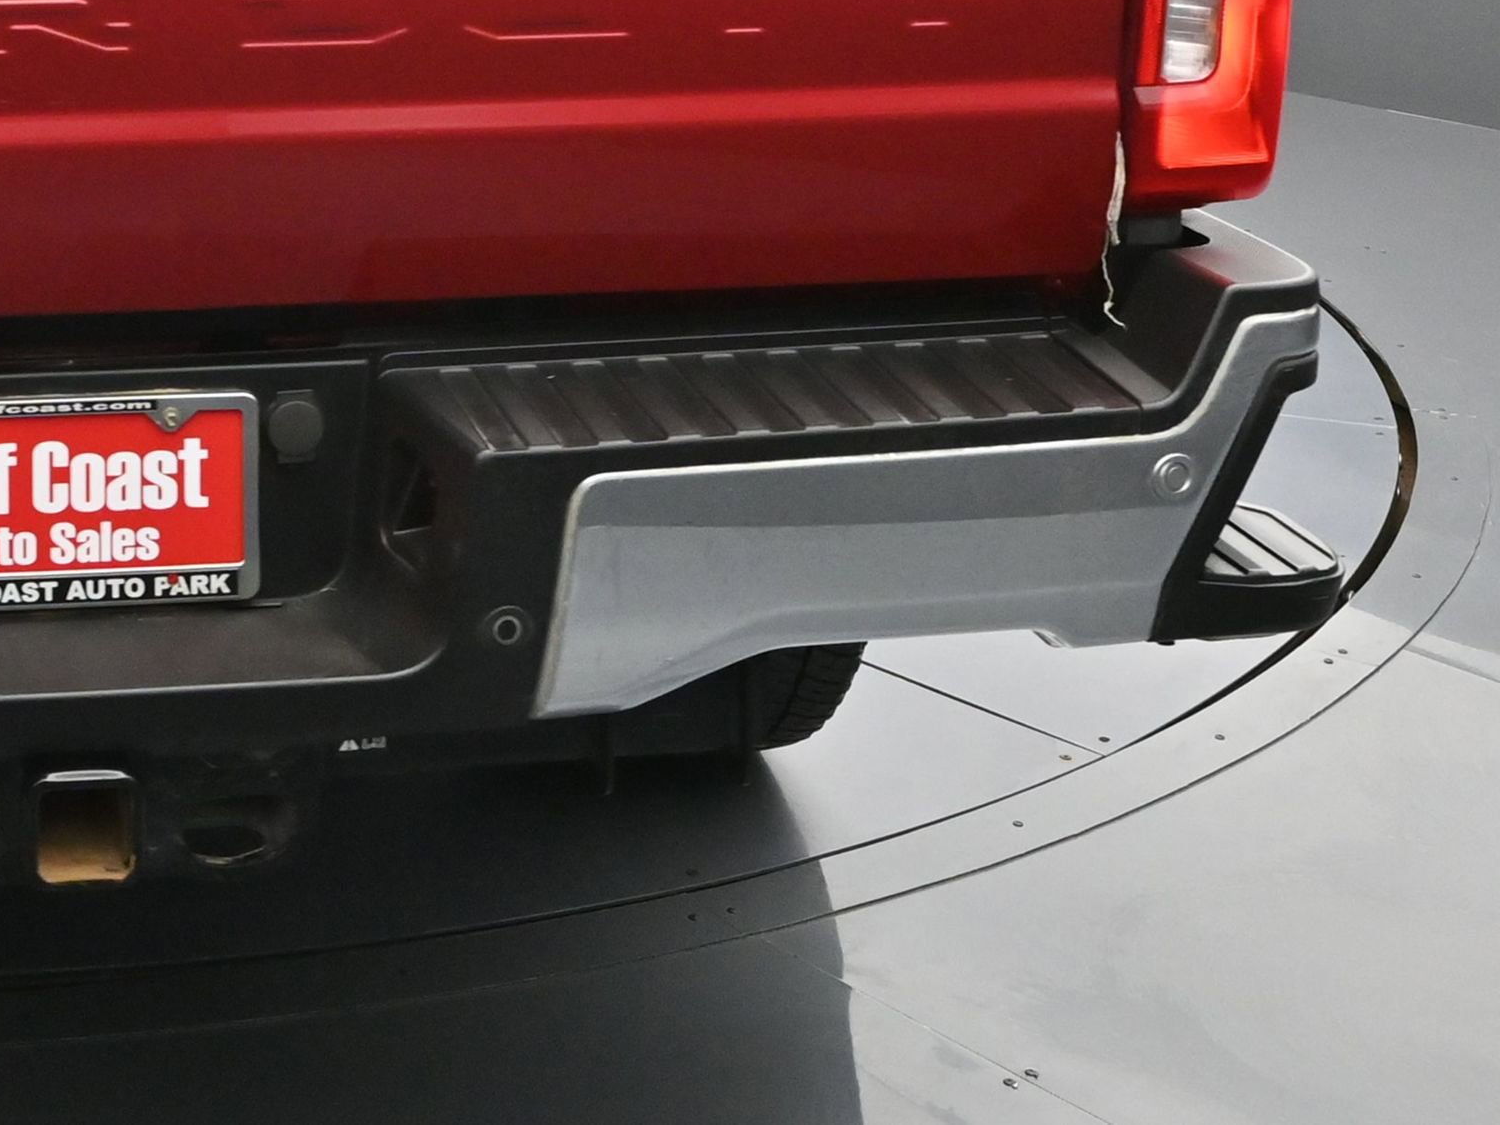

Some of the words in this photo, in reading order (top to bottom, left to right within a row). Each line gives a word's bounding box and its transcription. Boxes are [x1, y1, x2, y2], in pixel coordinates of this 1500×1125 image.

[31, 437, 209, 515] Coast
[49, 521, 161, 565] Sales
[65, 577, 147, 601] AUTO
[154, 573, 232, 596] PARK
